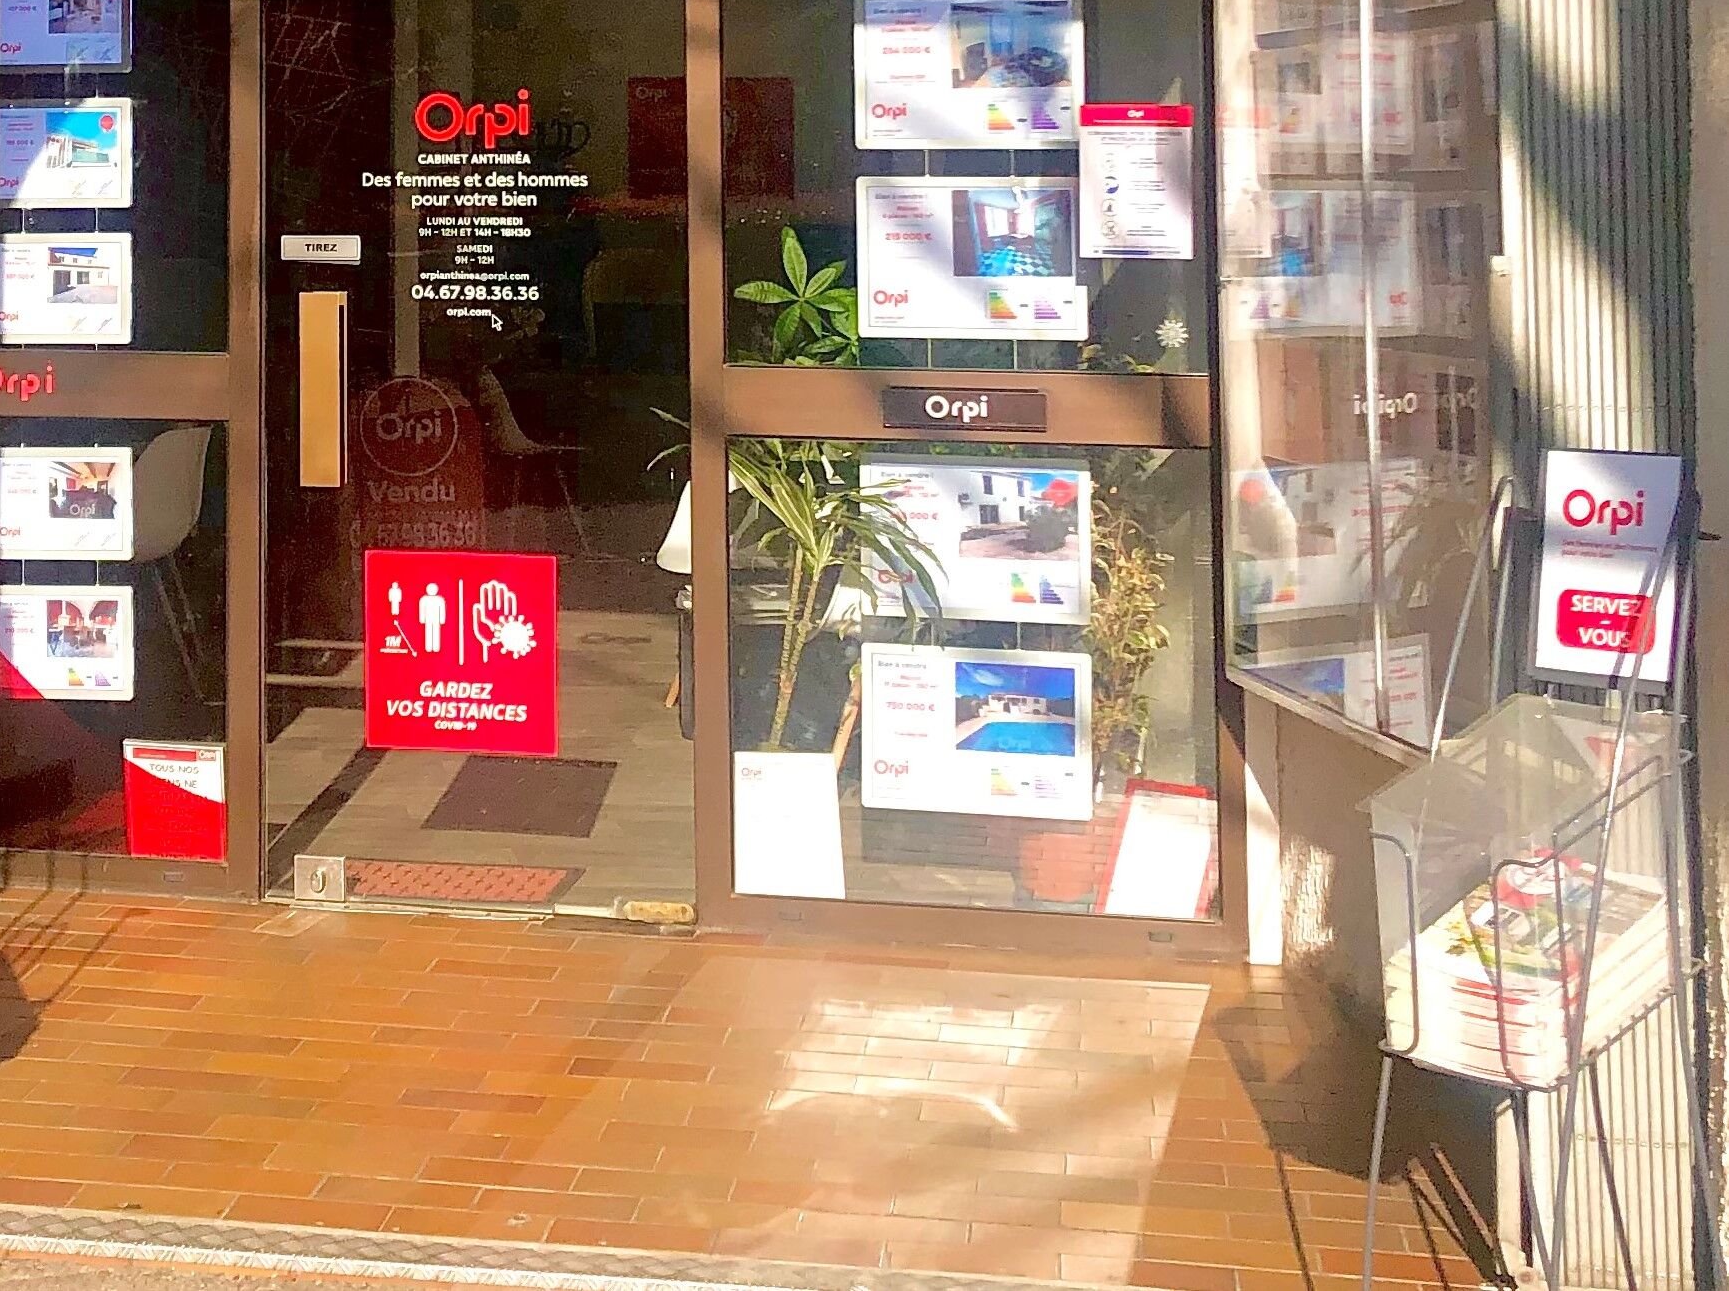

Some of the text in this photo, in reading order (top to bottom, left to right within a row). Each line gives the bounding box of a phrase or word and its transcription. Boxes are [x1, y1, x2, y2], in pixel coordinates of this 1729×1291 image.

[0, 42, 21, 54] Orpi
[415, 88, 531, 150] Orpi
[871, 103, 907, 120] Orpi
[417, 150, 531, 165] CABINET ANTHINÉA
[362, 171, 589, 187] Des femmes et des hommes
[411, 191, 537, 210] pour votre bien
[426, 216, 523, 226] LUNDI AU VENDREDI
[418, 227, 432, 237] 9H
[441, 227, 458, 237] 12H
[459, 227, 472, 237] ET
[473, 227, 492, 237] 14H
[501, 227, 531, 237] 18H30
[304, 243, 337, 252] TIREZ
[456, 244, 493, 253] SAMEDI
[454, 255, 468, 265] 9H
[477, 255, 495, 265] 12H
[411, 284, 540, 301] 04.67.98.36.36
[873, 289, 909, 308] Orpi
[446, 306, 492, 317] orpi.com
[924, 394, 989, 423] Orpi
[375, 409, 442, 445] Orpi
[367, 476, 456, 503] Vendu
[1562, 488, 1645, 536] Orpi
[384, 635, 402, 648] 1M
[419, 680, 494, 700] GARDEZ
[386, 699, 528, 722] VOS DISTANCES
[434, 720, 477, 731] COVID-19
[149, 762, 200, 775] TOUS NOS
[873, 759, 909, 778] Orpi
[184, 780, 198, 789] NE
